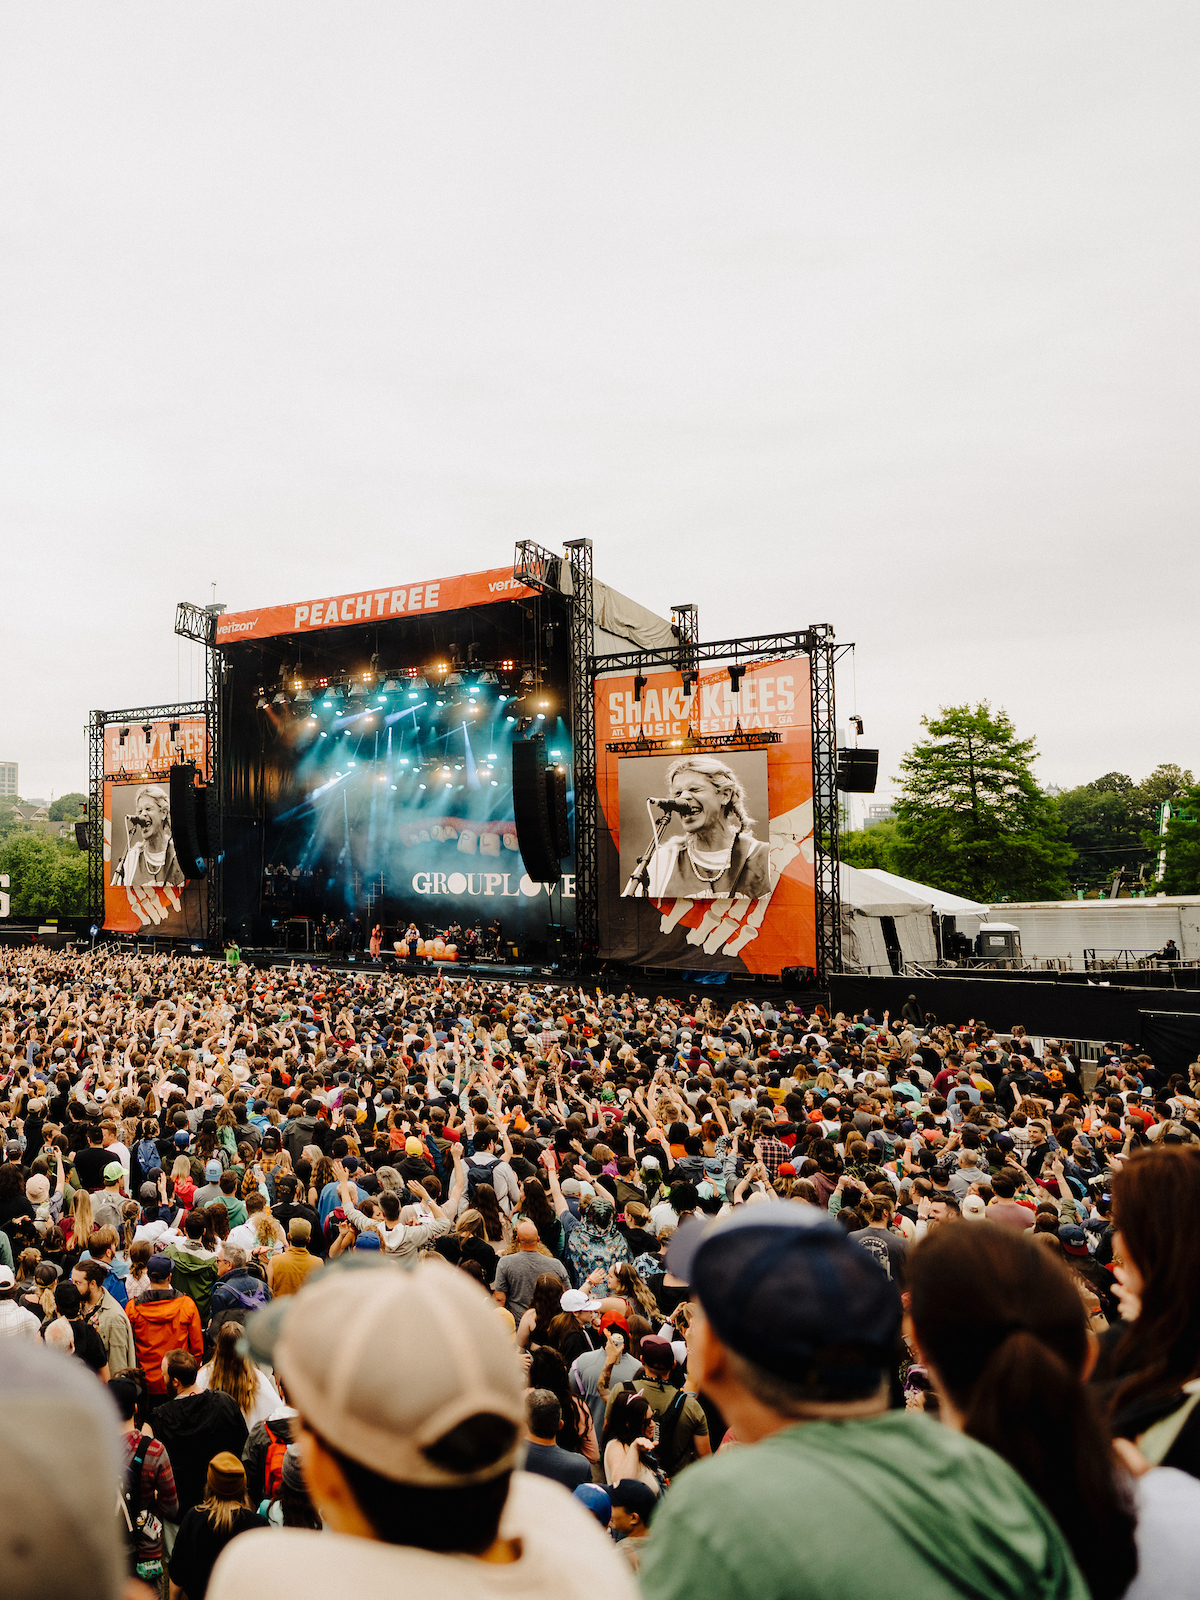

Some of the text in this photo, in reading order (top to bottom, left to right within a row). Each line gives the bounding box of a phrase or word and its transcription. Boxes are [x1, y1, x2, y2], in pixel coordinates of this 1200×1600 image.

[488, 576, 527, 592] veriz
[294, 583, 440, 629] PEACHTREE
[217, 621, 253, 635] verizon
[609, 675, 794, 725] SHAKY KNEES
[612, 714, 793, 738] ATL MUSIC FESTIVAL GA
[412, 872, 576, 897] GROUPLOVE
